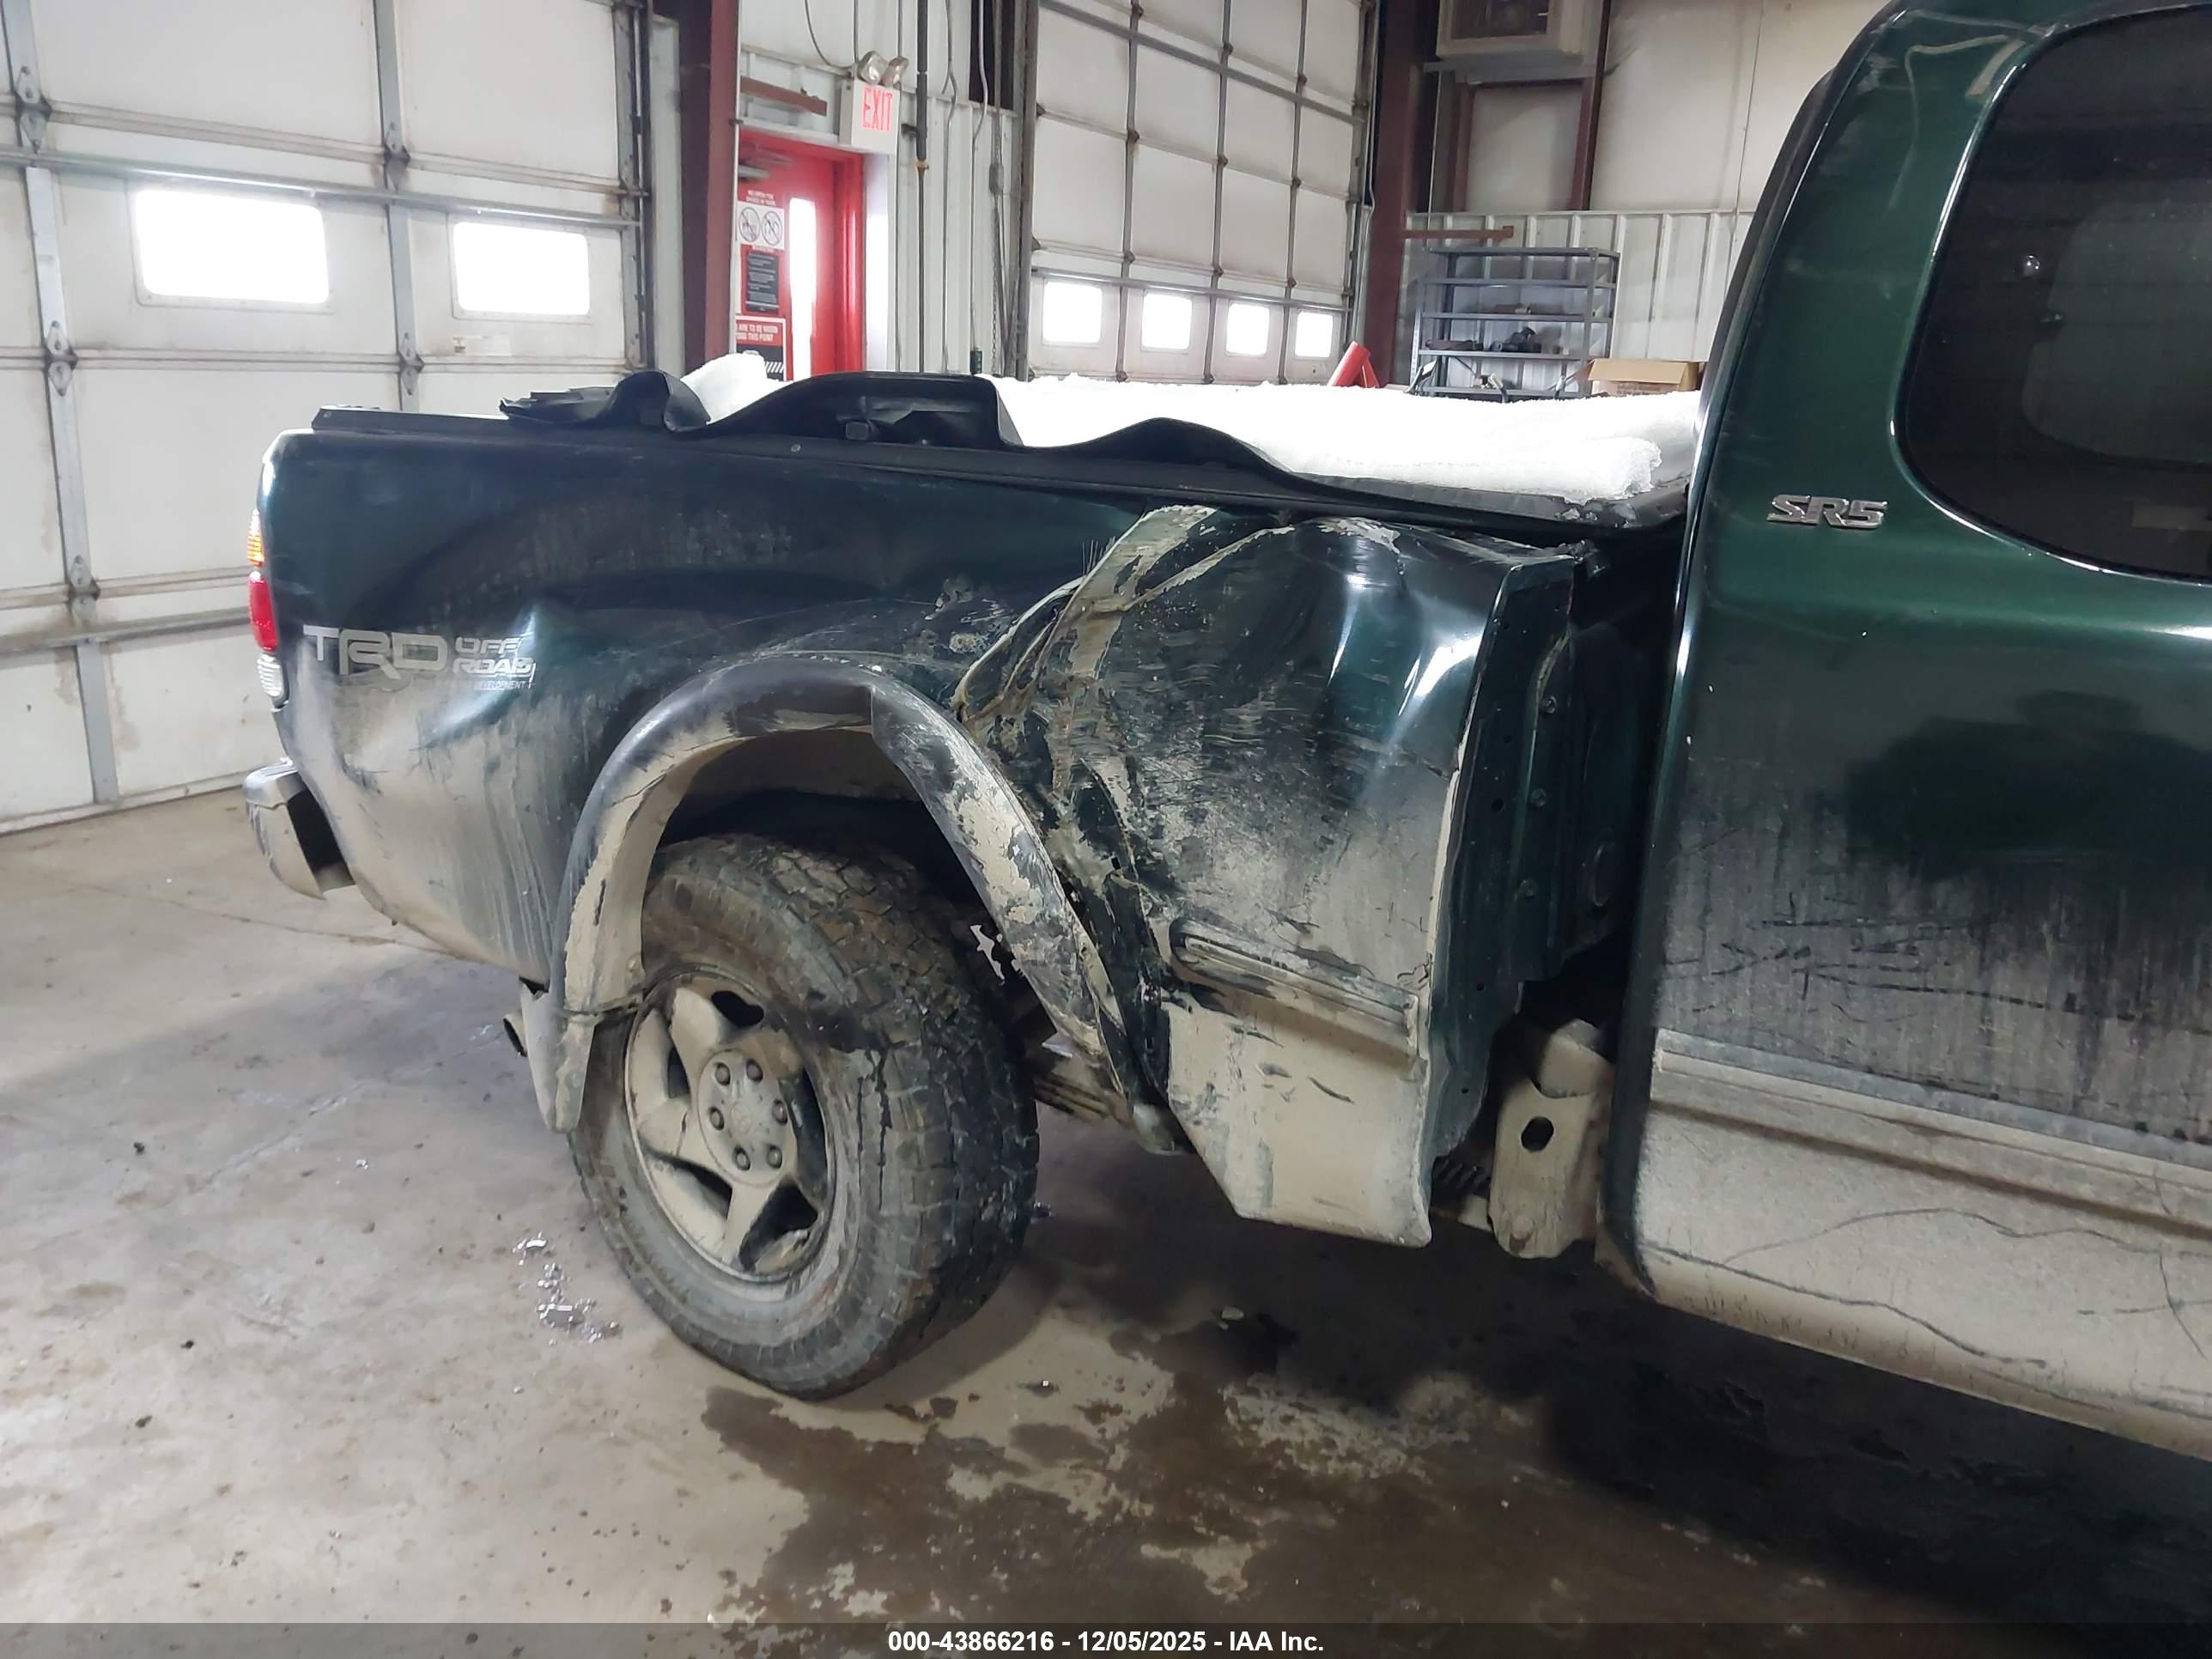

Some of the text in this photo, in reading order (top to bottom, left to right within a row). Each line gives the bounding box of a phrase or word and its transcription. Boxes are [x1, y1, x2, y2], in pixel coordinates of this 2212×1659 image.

[862, 87, 893, 131] EXIT
[1766, 495, 1887, 529] SR5
[302, 624, 447, 679] TRD
[455, 636, 524, 654] OFF
[453, 657, 535, 675] ROAD
